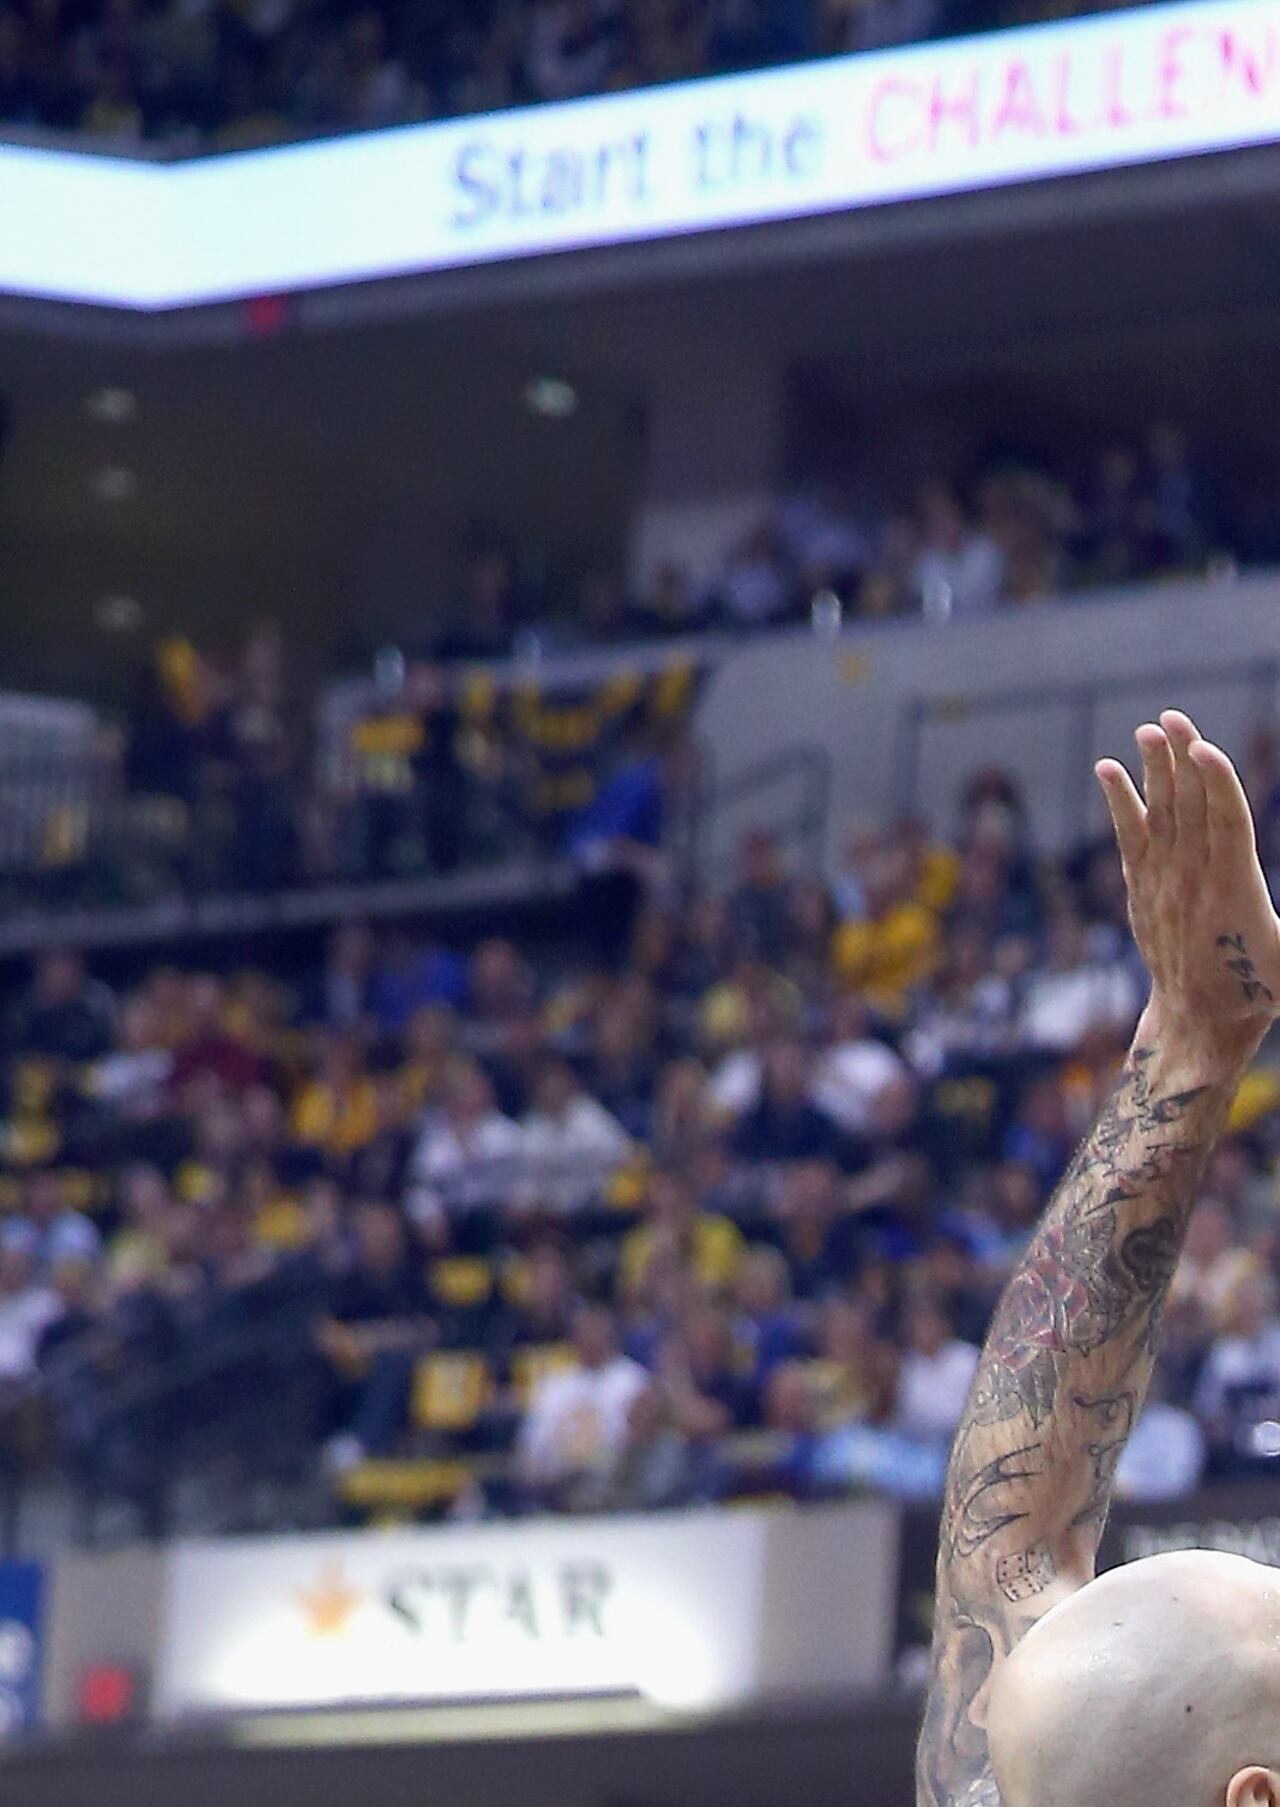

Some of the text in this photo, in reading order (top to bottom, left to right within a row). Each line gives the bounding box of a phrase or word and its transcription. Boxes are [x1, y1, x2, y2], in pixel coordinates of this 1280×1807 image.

[450, 122, 648, 231] Start
[695, 108, 822, 190] the
[381, 1557, 615, 1641] STAR
